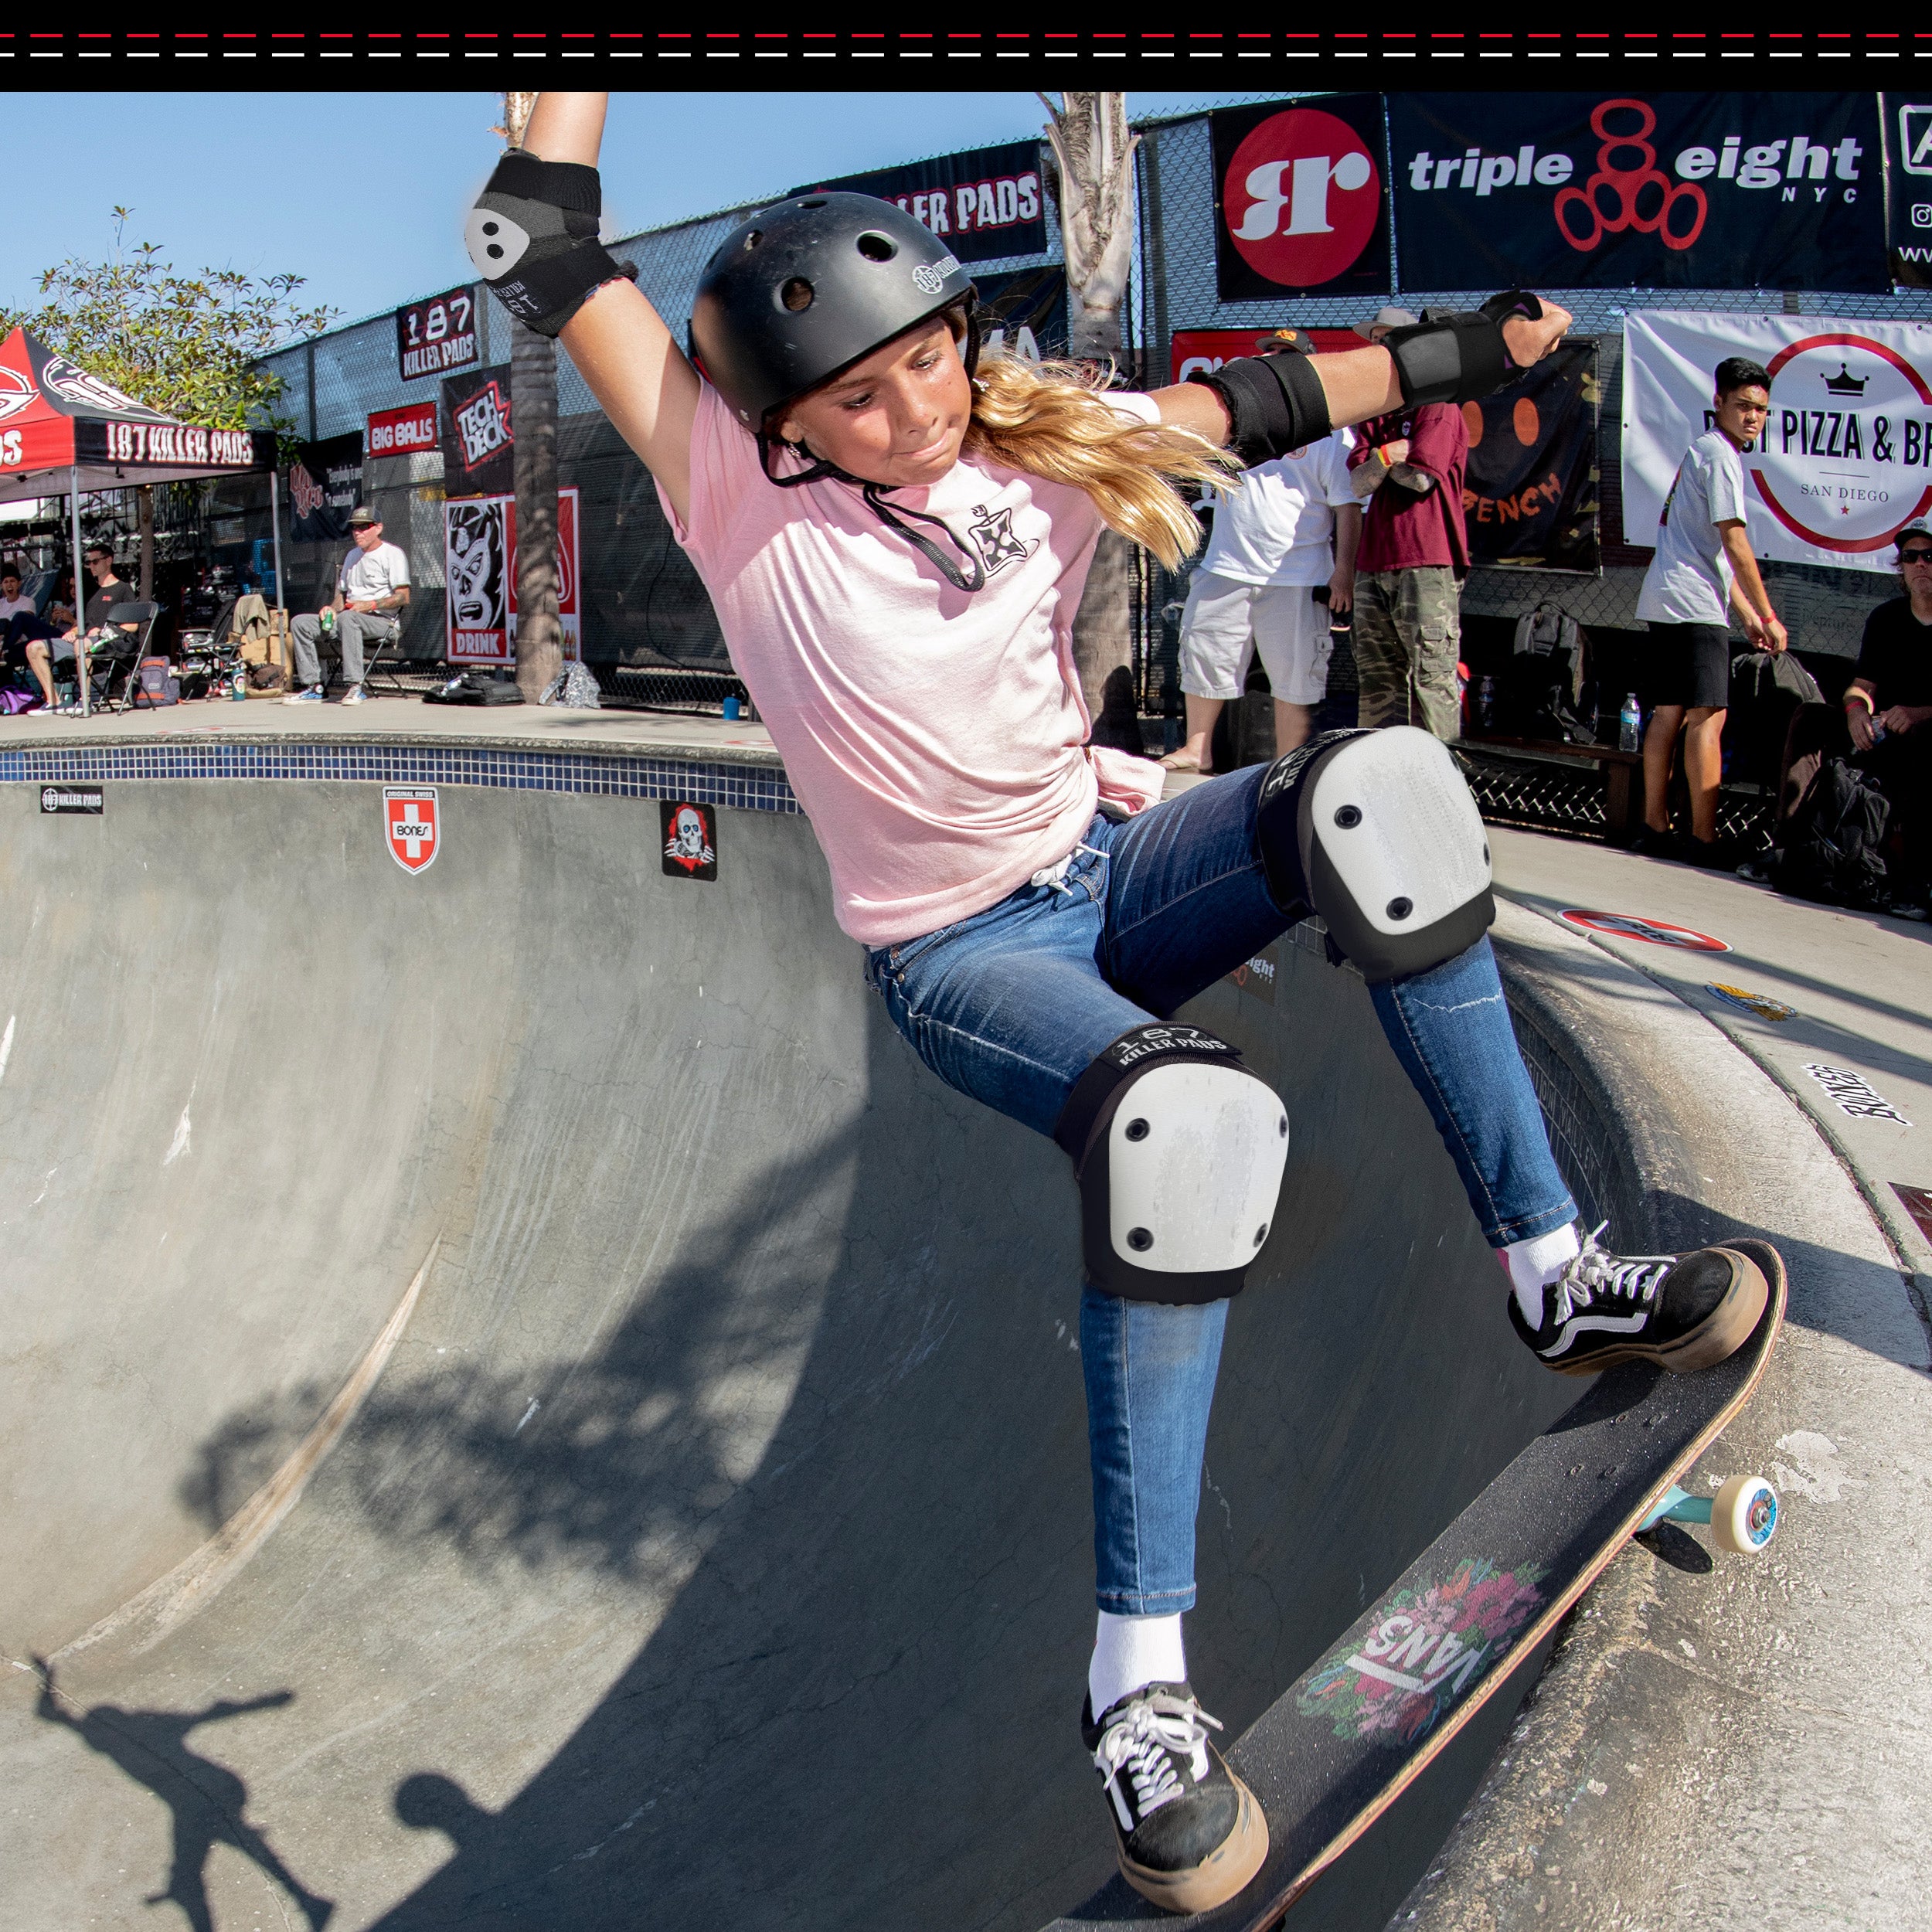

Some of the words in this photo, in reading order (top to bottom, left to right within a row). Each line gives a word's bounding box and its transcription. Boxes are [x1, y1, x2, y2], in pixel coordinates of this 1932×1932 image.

[1408, 145, 1573, 196] triple
[1674, 136, 1862, 189] eight
[956, 175, 1039, 230] PADS
[408, 296, 471, 346] 187
[403, 345, 441, 377] KILLER
[440, 333, 474, 366] PADS
[457, 390, 496, 434] TECH
[107, 423, 148, 461] 187
[148, 426, 208, 463] KILLER
[211, 430, 254, 464] PADS
[372, 425, 393, 450] BIG
[395, 417, 433, 447] BALLS
[464, 412, 508, 464] DECK
[1781, 410, 1864, 460] PIZZA
[1872, 415, 1895, 464] &
[1801, 484, 1832, 498] SAN
[1838, 488, 1889, 503] DIEGO
[456, 631, 501, 655] DRINK
[59, 794, 83, 806] KILLER
[83, 794, 102, 807] PADS
[1245, 957, 1275, 978] ight
[1117, 1026, 1199, 1054] 187
[1119, 1039, 1176, 1066] KILLER
[1175, 1038, 1227, 1050] PADS
[1345, 1614, 1492, 1694] VANS
